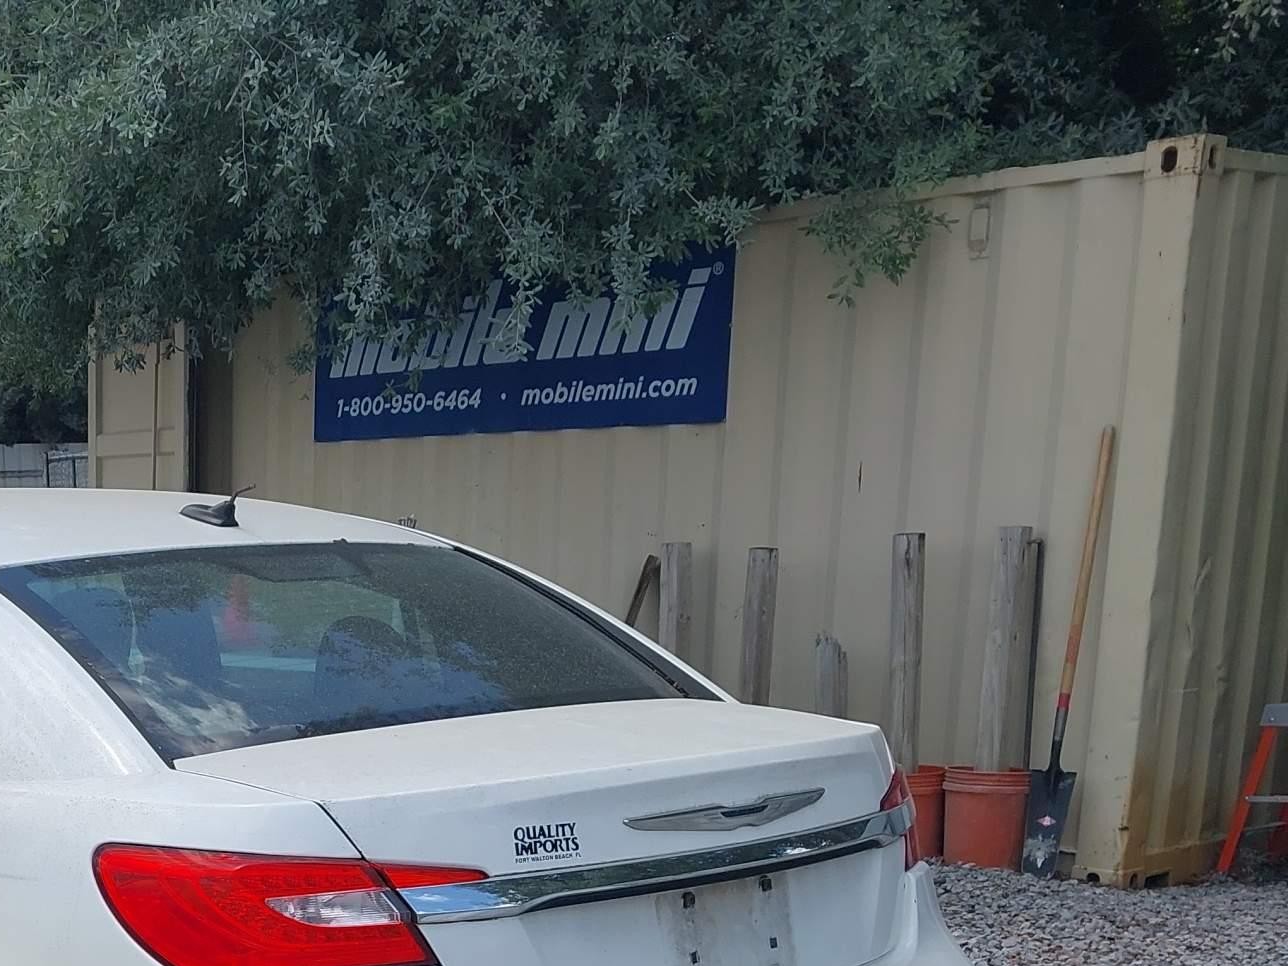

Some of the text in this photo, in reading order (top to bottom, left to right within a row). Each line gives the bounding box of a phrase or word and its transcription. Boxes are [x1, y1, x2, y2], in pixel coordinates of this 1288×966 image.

[337, 376, 698, 418] 1-800-950-6464 mobilemini.com
[514, 822, 576, 844] QUALITY
[515, 837, 579, 856] IMPORTS
